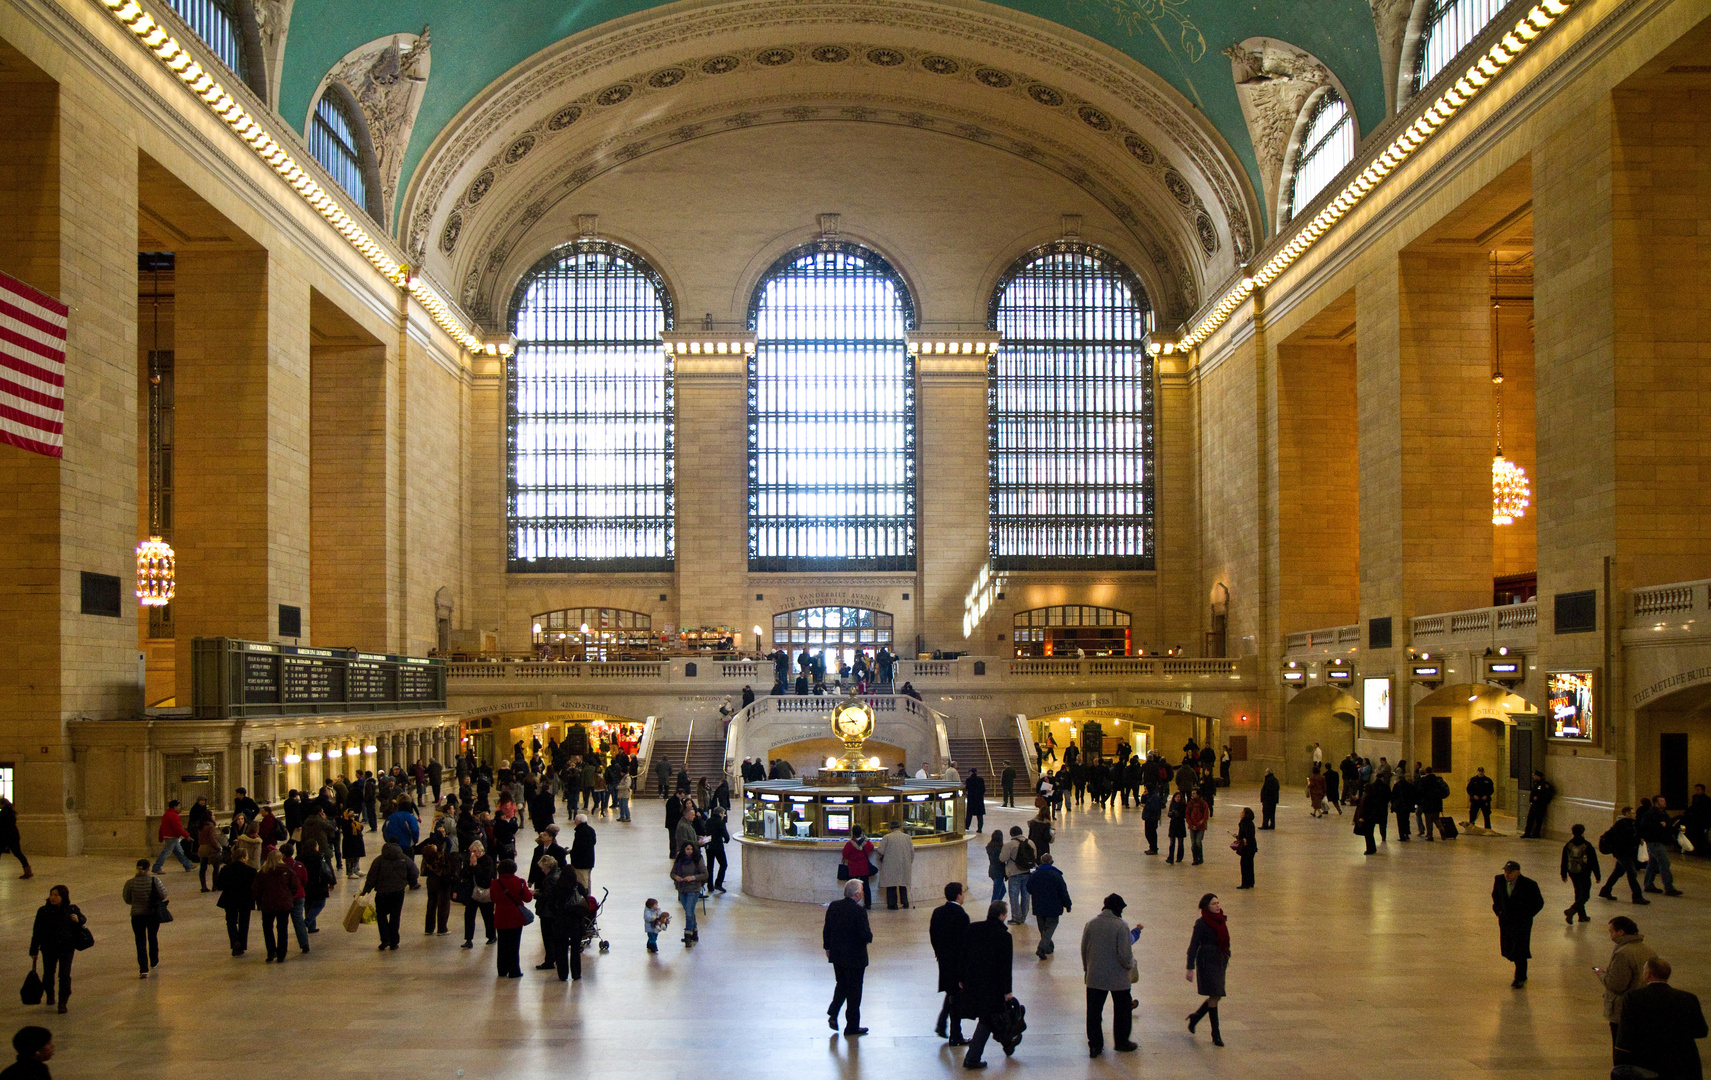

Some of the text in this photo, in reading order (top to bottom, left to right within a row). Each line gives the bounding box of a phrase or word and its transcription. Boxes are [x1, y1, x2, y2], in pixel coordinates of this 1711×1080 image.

[800, 592, 846, 600] VANDERBILT
[851, 593, 880, 601] AVENUE
[780, 598, 887, 610] THE CAMPBELL APARTMENT
[1633, 688, 1651, 704] THE
[1650, 672, 1686, 695] METLIFE
[560, 701, 610, 712] 42ND STREET
[1042, 703, 1068, 713] TICKET
[1549, 696, 1569, 709] PAWN
[468, 701, 535, 716] SUBWAY SHUTTLE
[1084, 709, 1134, 719] WAITING ROOM
[771, 737, 791, 747] DINING
